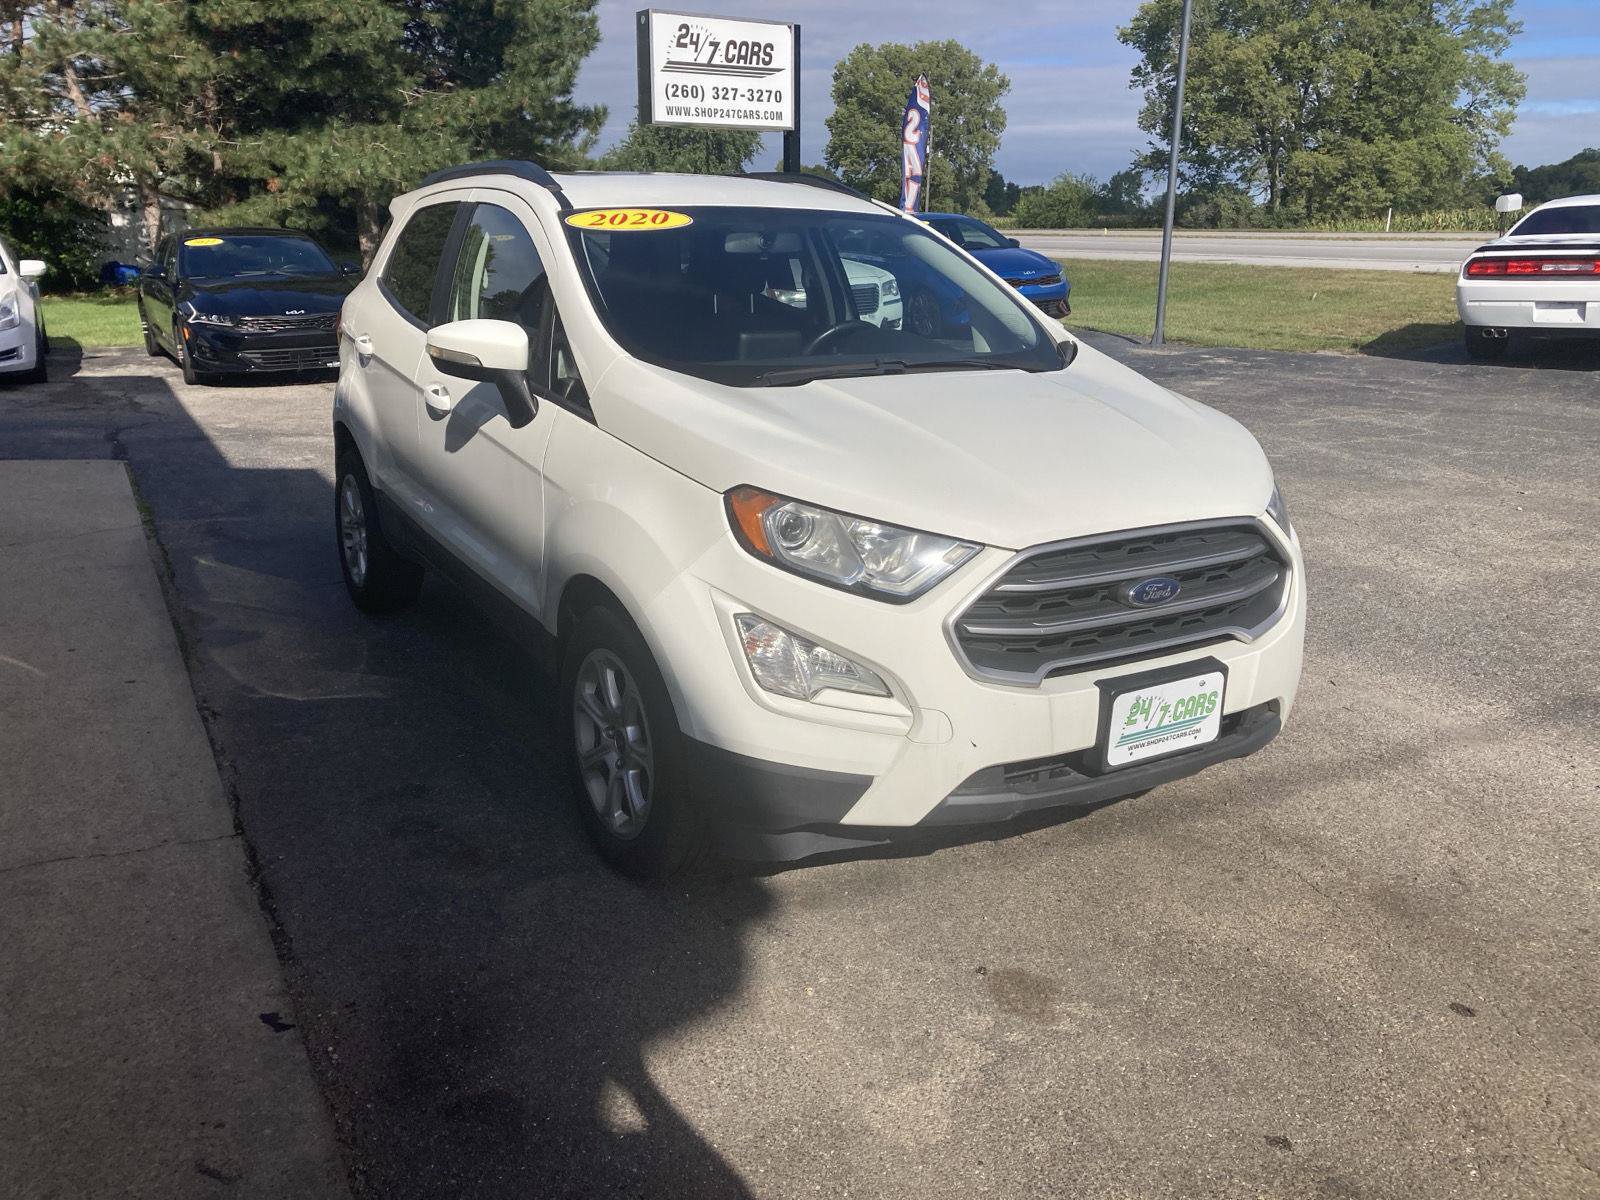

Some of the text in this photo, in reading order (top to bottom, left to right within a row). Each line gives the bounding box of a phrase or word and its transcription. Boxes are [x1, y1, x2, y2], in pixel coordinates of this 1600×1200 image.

[675, 23, 775, 66] 24/7 CARS
[665, 83, 782, 103] (260) 327-3270
[665, 105, 783, 121] WWW.SHOP247CARS.COM
[589, 212, 670, 226] 2020
[1143, 583, 1172, 601] Ford
[1172, 690, 1219, 722] CARS
[1127, 727, 1202, 751] WWW.SHOP247CARS.COM
